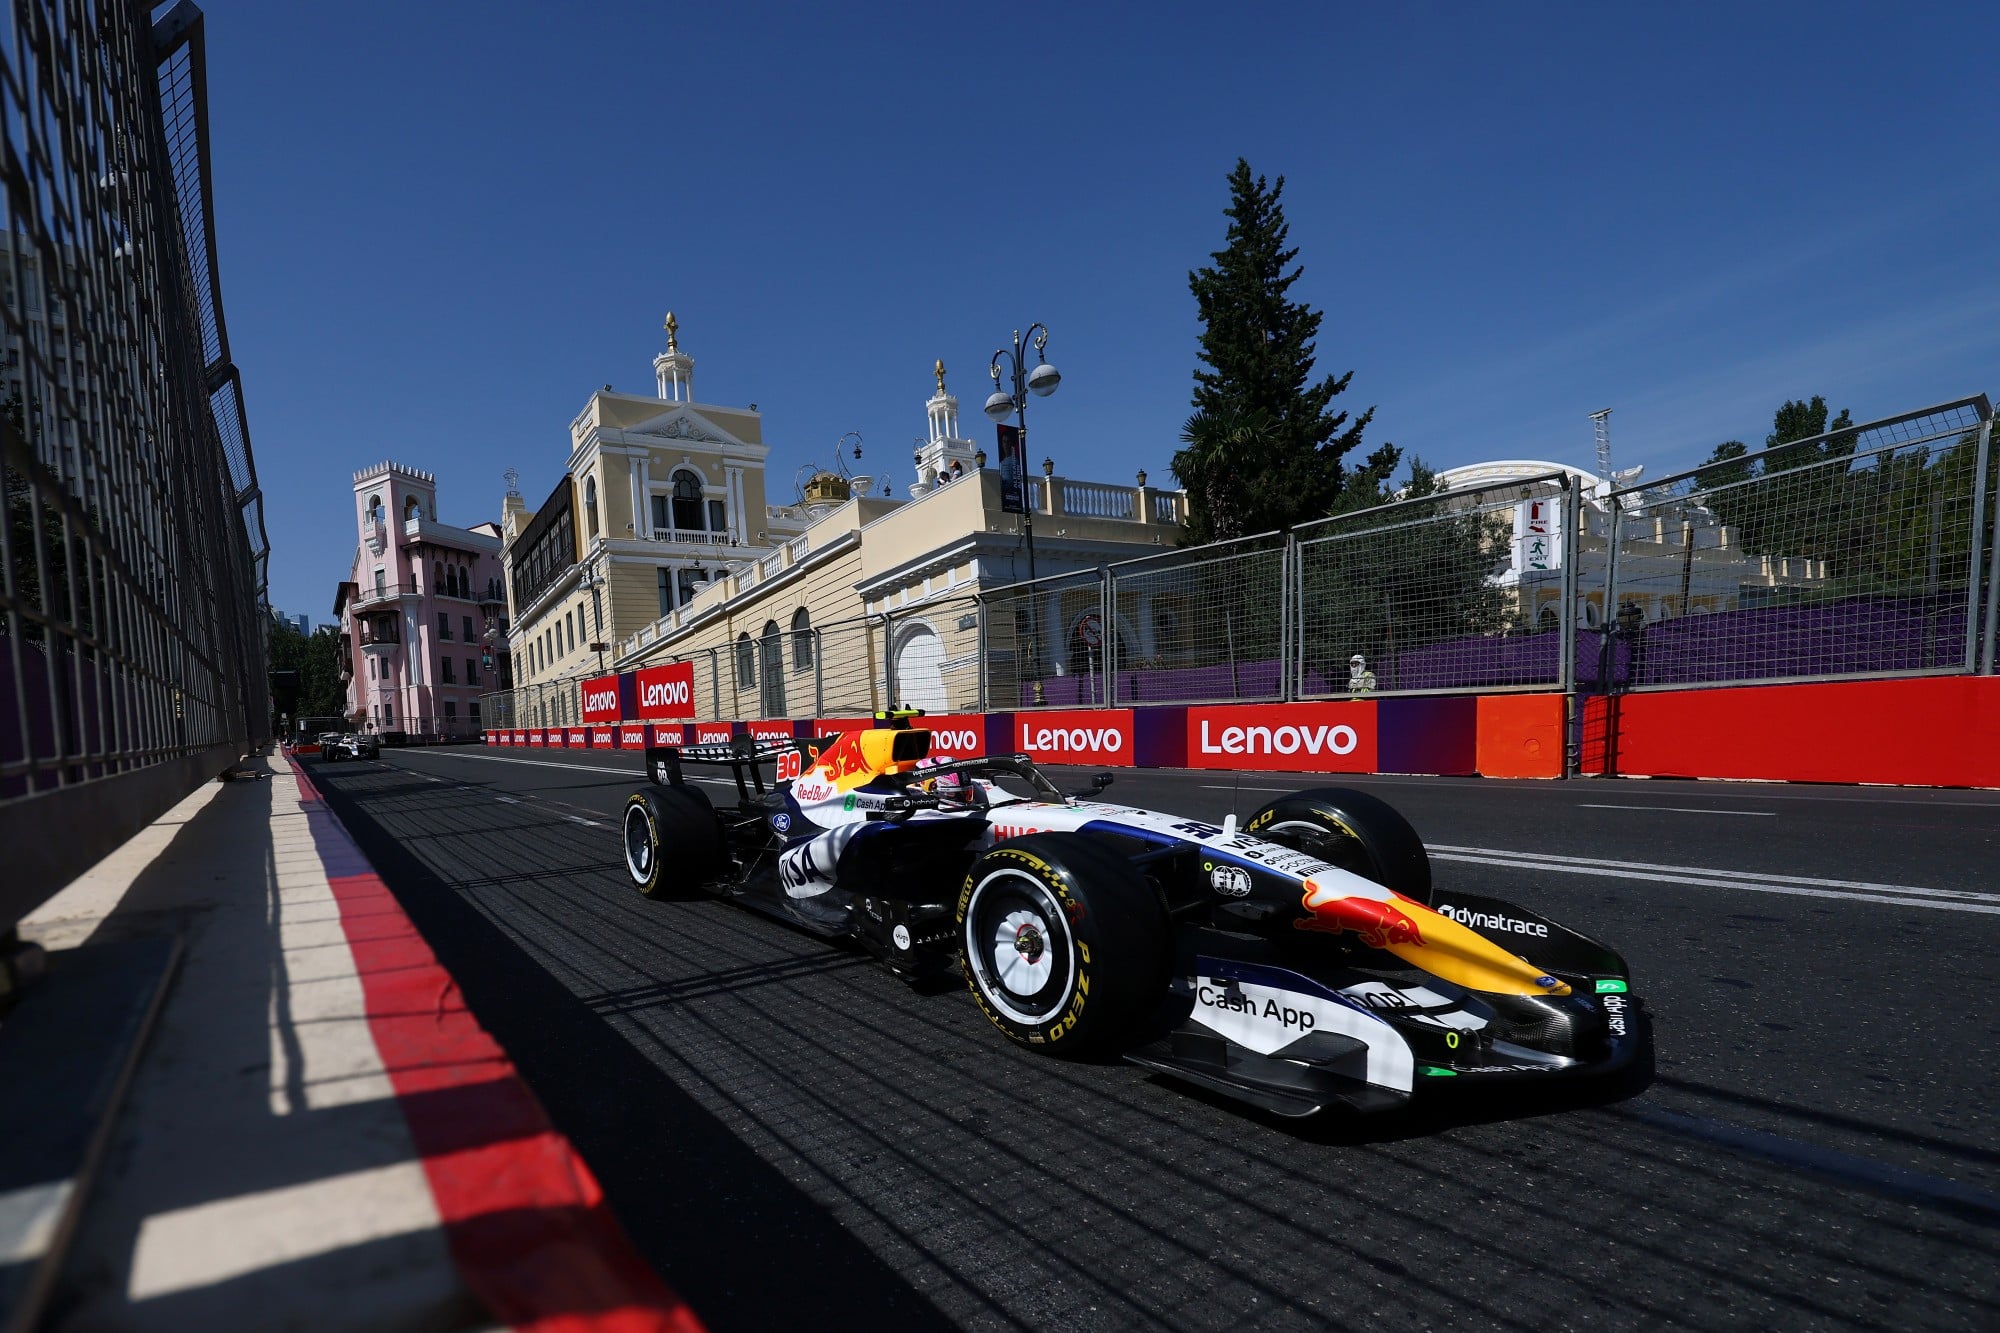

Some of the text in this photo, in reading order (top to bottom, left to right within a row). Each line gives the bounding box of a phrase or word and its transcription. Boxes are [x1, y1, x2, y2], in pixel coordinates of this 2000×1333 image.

[584, 690, 616, 713] Lenovo
[641, 680, 689, 707] Lenovo
[568, 731, 585, 743] Lenovo
[593, 730, 611, 744] Lenovo
[622, 729, 643, 744] Lenovo
[656, 729, 682, 744] Lenovo
[698, 730, 730, 745] Lenovo
[930, 730, 977, 751] novo
[1023, 723, 1122, 752] Lenovo
[1202, 720, 1357, 755] Lenovo
[777, 752, 800, 781] 30
[856, 798, 874, 810] Cash
[875, 799, 887, 812] Ap
[1245, 809, 1275, 833] RO
[994, 824, 1055, 843] HUG
[781, 843, 832, 890] VISA
[956, 874, 974, 924] PIRELLI
[1455, 907, 1548, 938] dynatrace
[1050, 938, 1091, 1042] P ZERO
[1198, 986, 1257, 1018] Cash
[1262, 998, 1316, 1030] App
